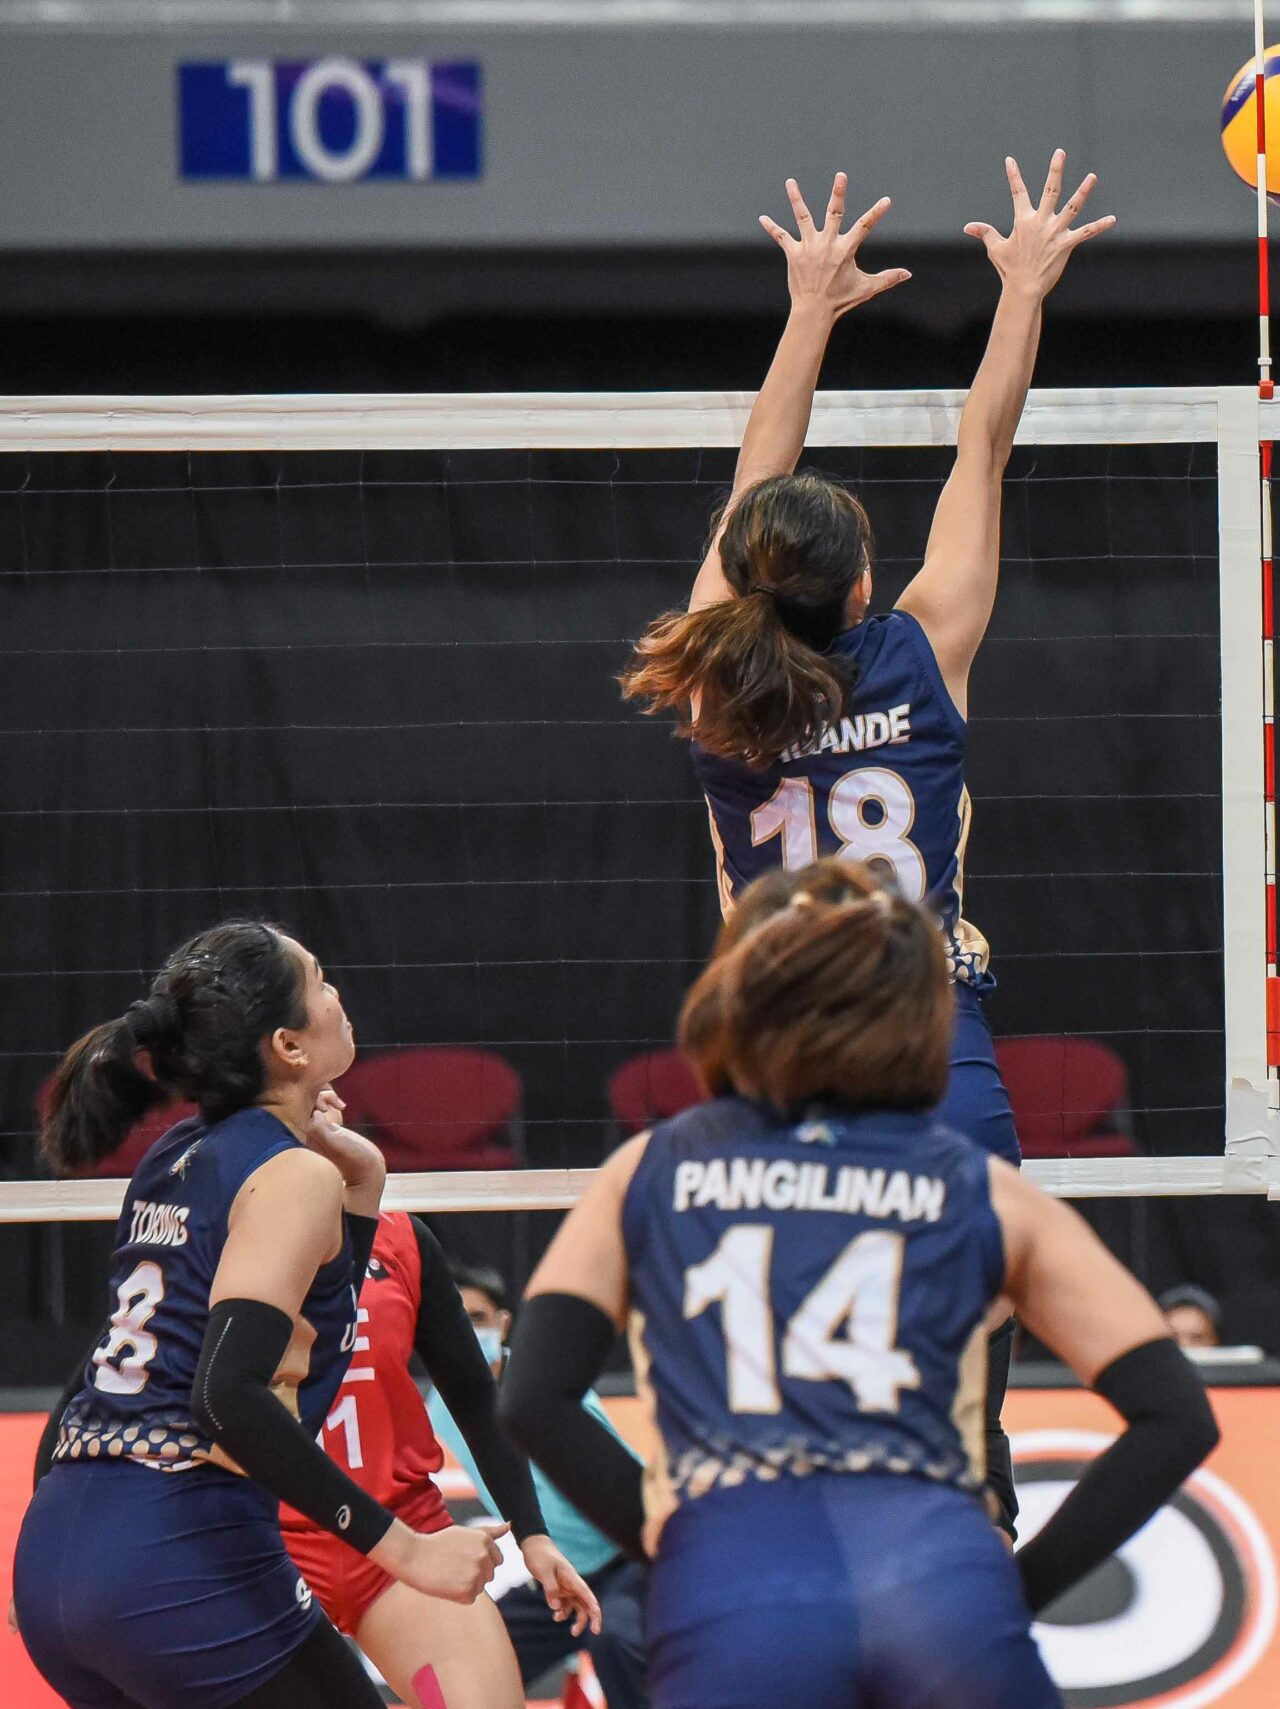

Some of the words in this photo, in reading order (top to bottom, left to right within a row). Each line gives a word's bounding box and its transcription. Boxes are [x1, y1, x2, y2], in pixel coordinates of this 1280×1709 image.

[229, 58, 432, 181] 101
[779, 703, 911, 763] ANDE
[750, 766, 927, 901] 18
[129, 1200, 190, 1246] TORING
[672, 1157, 946, 1223] PANGILINAN
[92, 1261, 164, 1395] 8
[683, 1222, 921, 1415] 14
